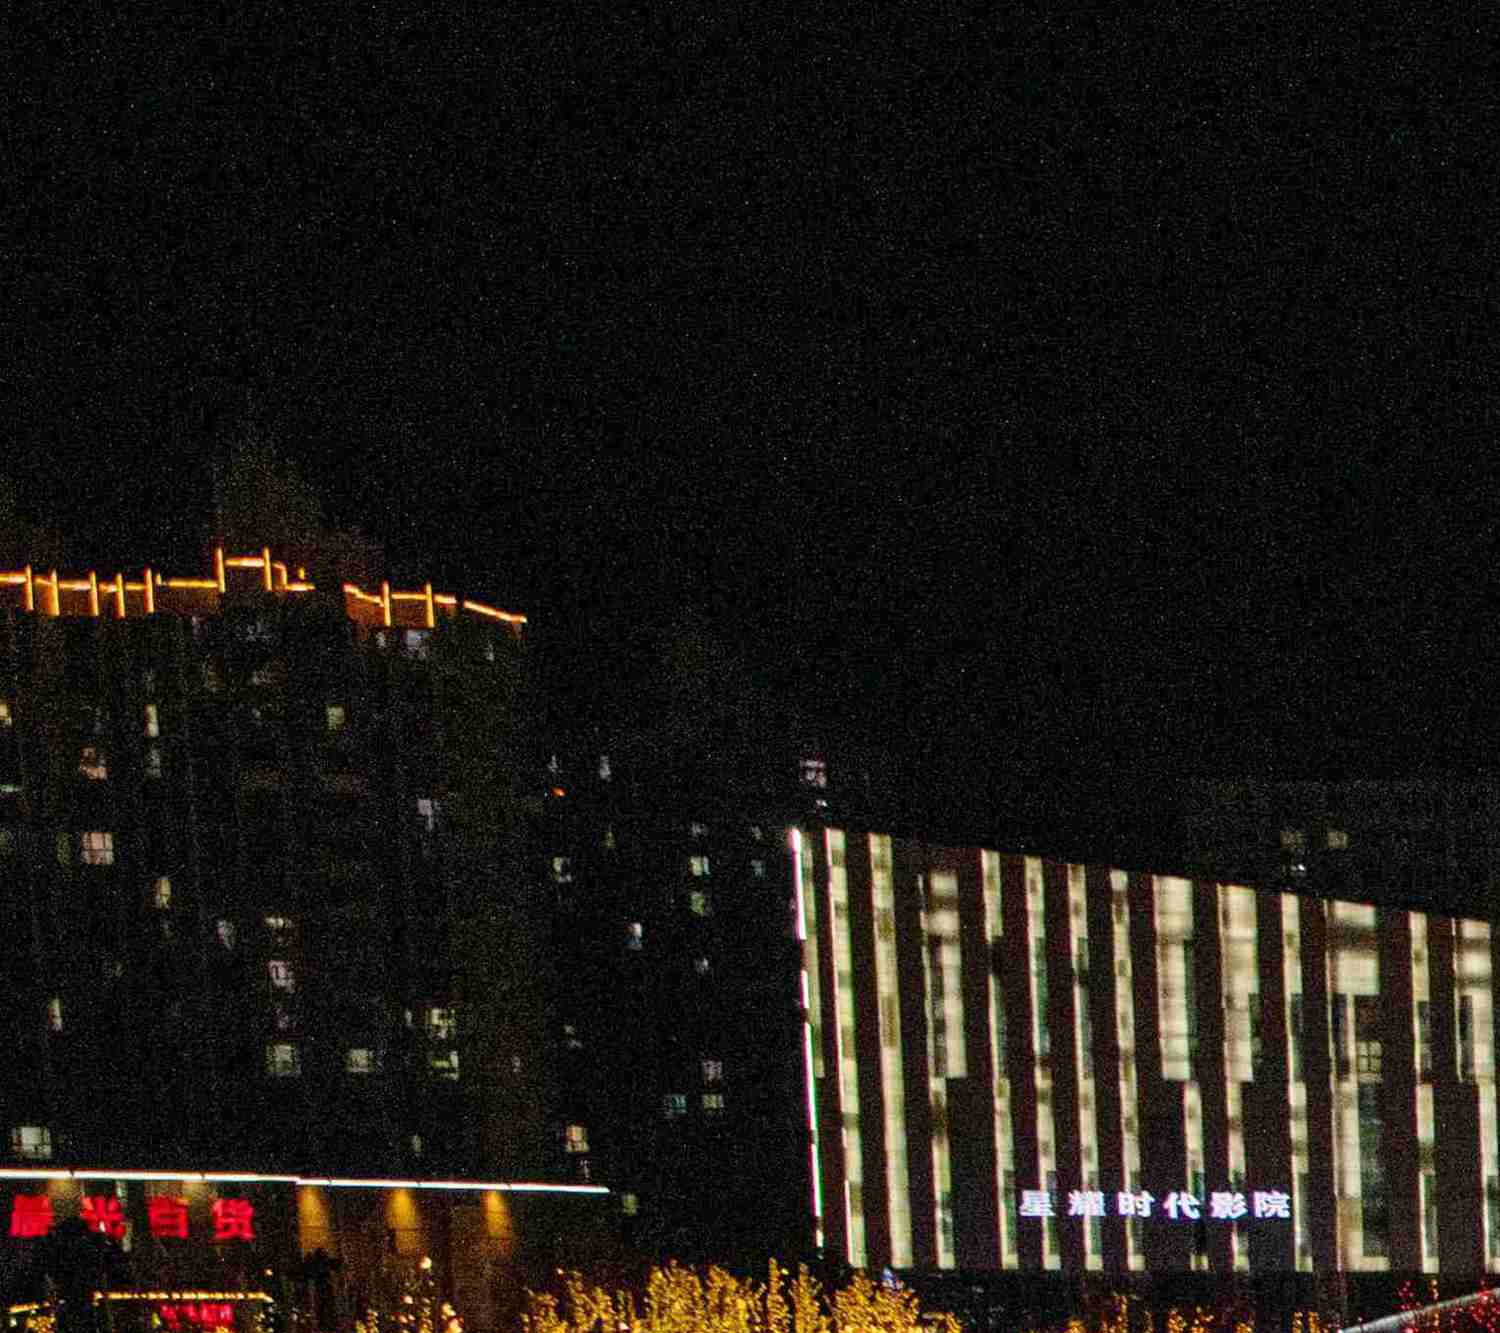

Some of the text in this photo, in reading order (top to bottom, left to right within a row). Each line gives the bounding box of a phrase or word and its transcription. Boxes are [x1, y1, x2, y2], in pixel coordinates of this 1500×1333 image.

[1019, 1190, 1292, 1219] 星耀时代影院
